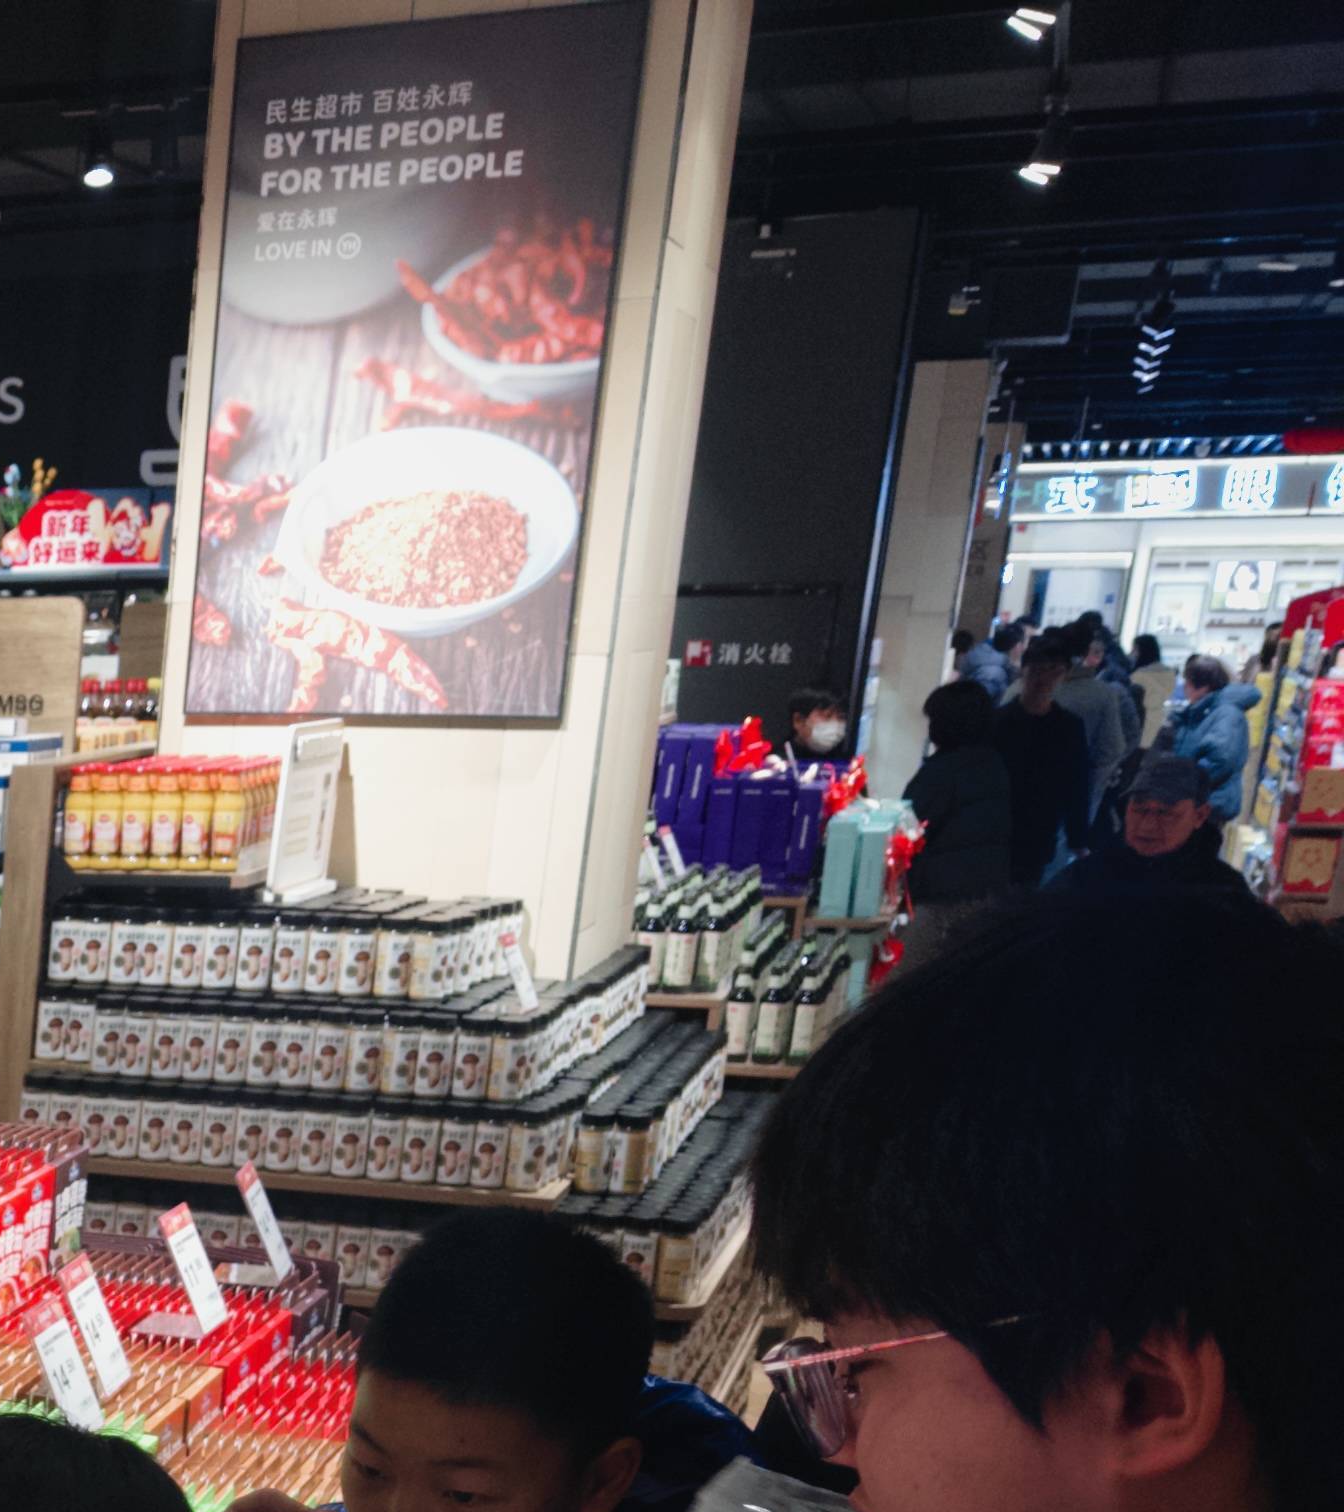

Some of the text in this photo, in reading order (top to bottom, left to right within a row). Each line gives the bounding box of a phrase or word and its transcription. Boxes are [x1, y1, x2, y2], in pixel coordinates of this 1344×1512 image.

[266, 81, 473, 125] 民生超市 百姓永辉
[264, 112, 504, 159] BY THE PEOPLE
[260, 149, 524, 197] FOR THE PEOPLE
[257, 207, 338, 233] 爱在永辉
[255, 241, 307, 261] LOVE
[311, 239, 332, 257] IN
[718, 642, 793, 665] 消火栓
